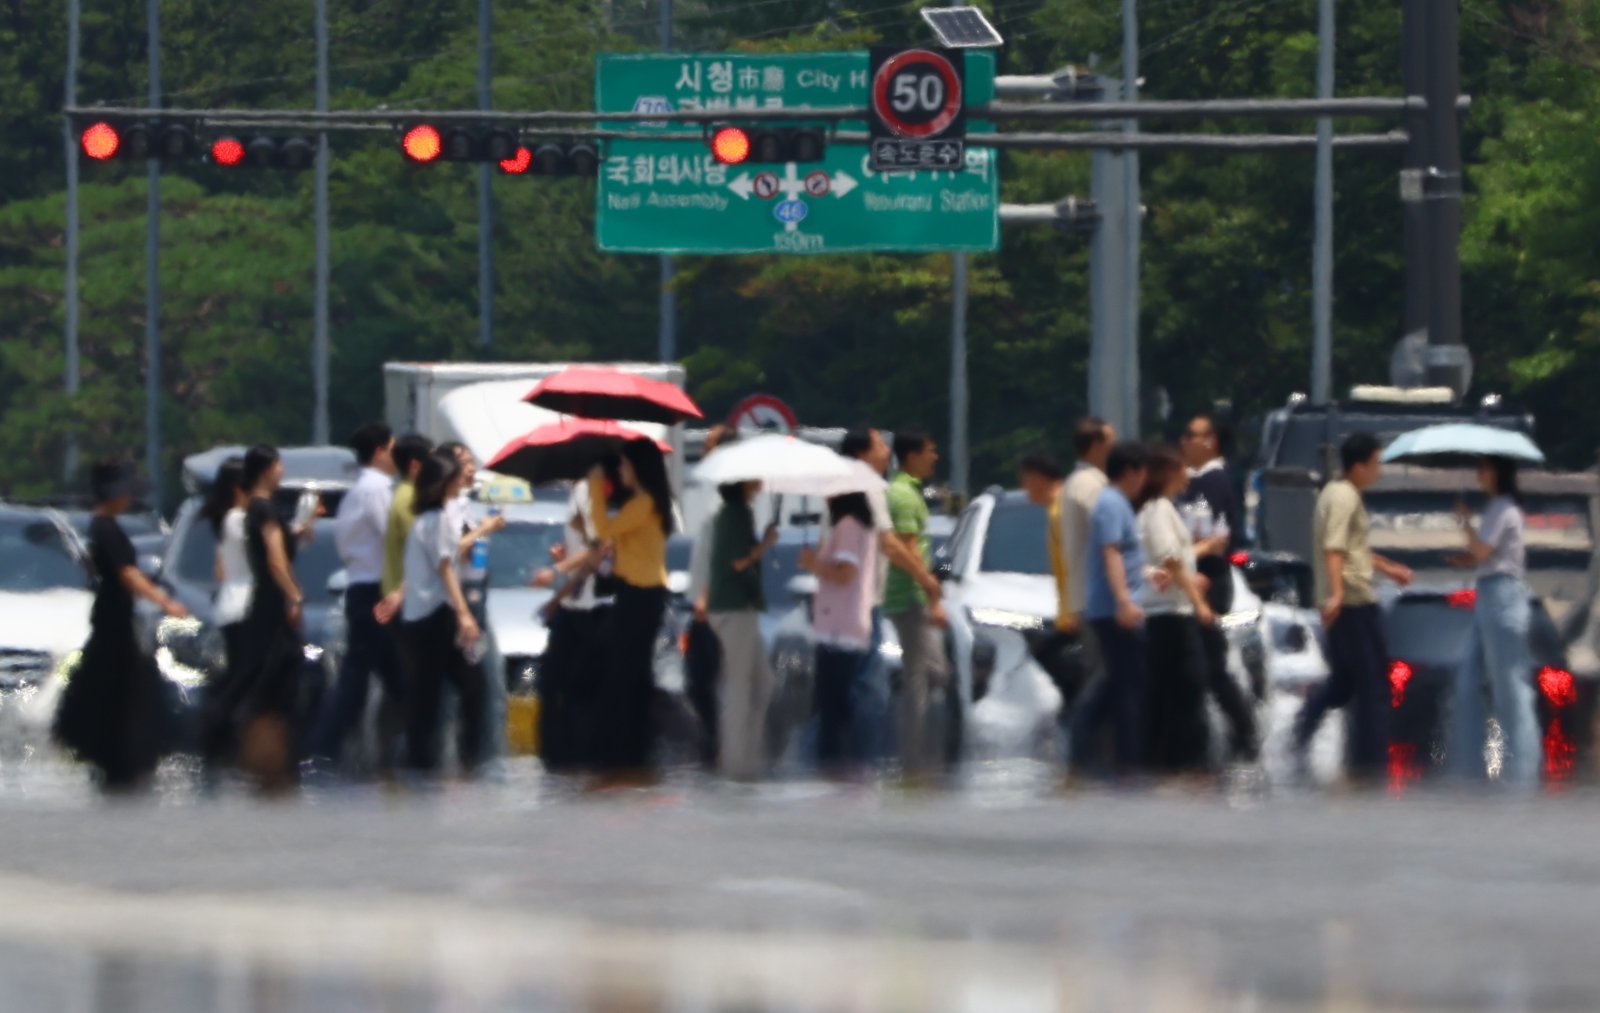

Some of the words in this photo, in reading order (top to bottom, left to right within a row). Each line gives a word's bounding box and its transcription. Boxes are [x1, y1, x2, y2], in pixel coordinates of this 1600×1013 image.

[674, 60, 734, 93] 시청
[797, 69, 841, 93] City
[851, 70, 867, 87] H
[892, 73, 945, 112] 50
[606, 153, 728, 186] 국회의사당
